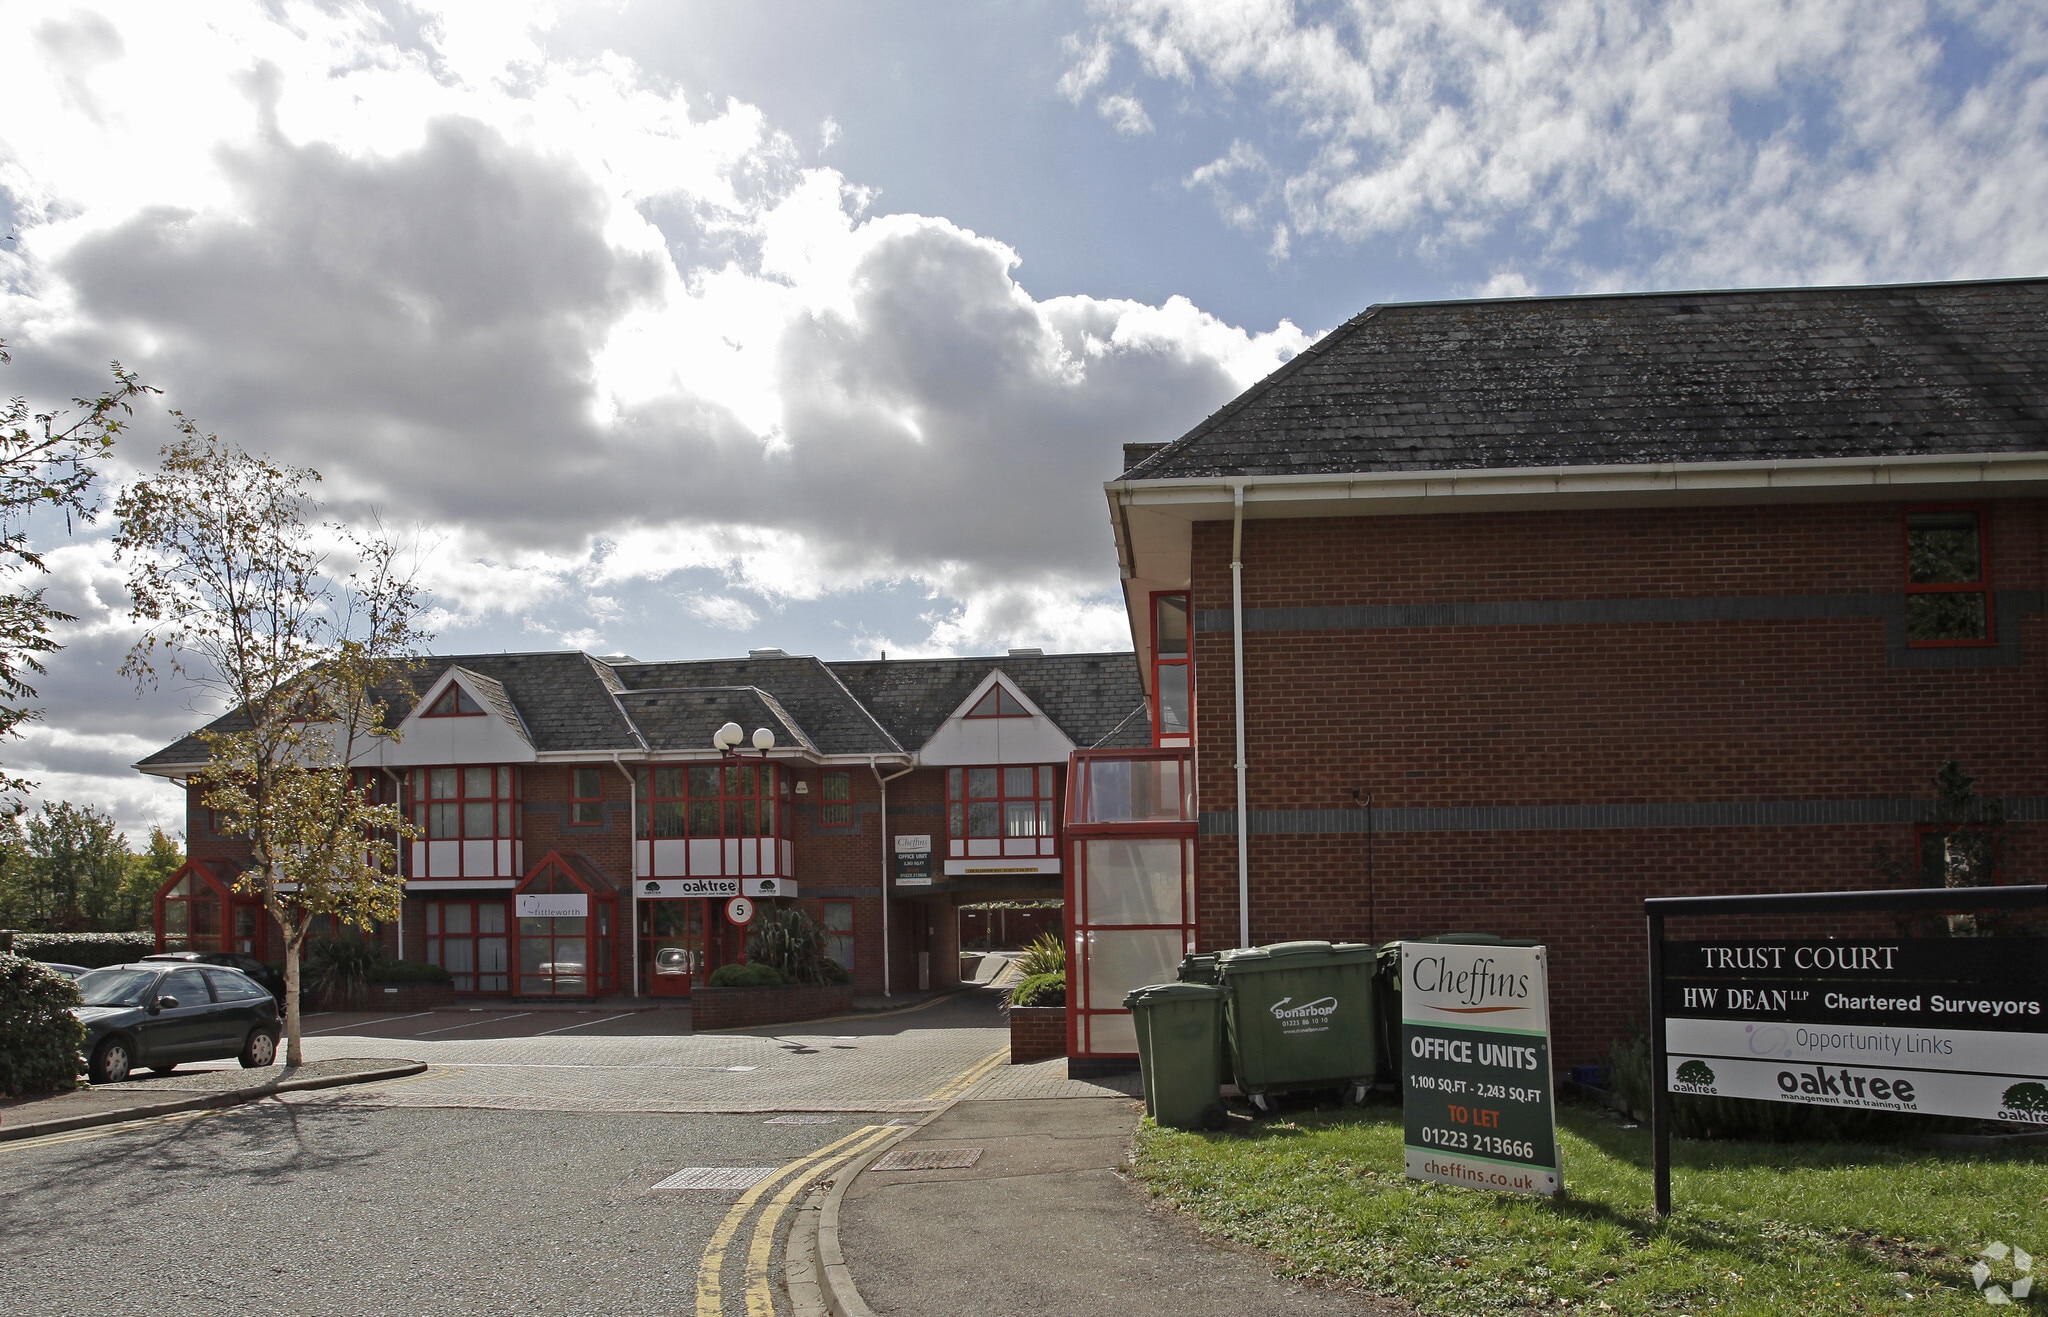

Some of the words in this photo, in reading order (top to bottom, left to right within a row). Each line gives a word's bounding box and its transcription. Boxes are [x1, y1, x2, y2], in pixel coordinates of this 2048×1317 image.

[898, 838, 928, 847] Cheffins
[683, 880, 737, 892] oaktree
[534, 908, 581, 916] fittleworth
[736, 904, 744, 916] 5
[1701, 946, 1786, 970] TRUST
[1794, 945, 1899, 970] COURT
[1412, 956, 1529, 1006] Cheffins
[1275, 1006, 1333, 1019] Donarbon
[1683, 987, 1719, 1009] HW
[1726, 988, 1787, 1012] DEAN
[1790, 989, 1809, 1001] LLP
[1824, 993, 1921, 1012] Chartered
[1930, 995, 2041, 1017] Surveyors
[1410, 1035, 1472, 1064] OFFICE
[1478, 1043, 1538, 1071] UNITS
[1796, 1028, 1902, 1056] Opportunity
[1906, 1033, 1953, 1055] Links
[1410, 1074, 1435, 1090] 1,100
[1438, 1078, 1467, 1095] SQ.FT
[1477, 1083, 1506, 1099] 2,243
[1509, 1087, 1542, 1104] SQ.FT
[1777, 1066, 1916, 1102] oaktree
[1781, 1093, 1839, 1104] management
[1842, 1098, 1861, 1106] and
[1863, 1099, 1901, 1110] training
[1903, 1102, 1918, 1111] ltd
[1448, 1104, 1469, 1124] TO
[1473, 1108, 1500, 1128] LET
[1422, 1126, 1468, 1149] 01223
[1473, 1134, 1534, 1159] 213666
[1424, 1159, 1534, 1190] cheffins.co.uk
